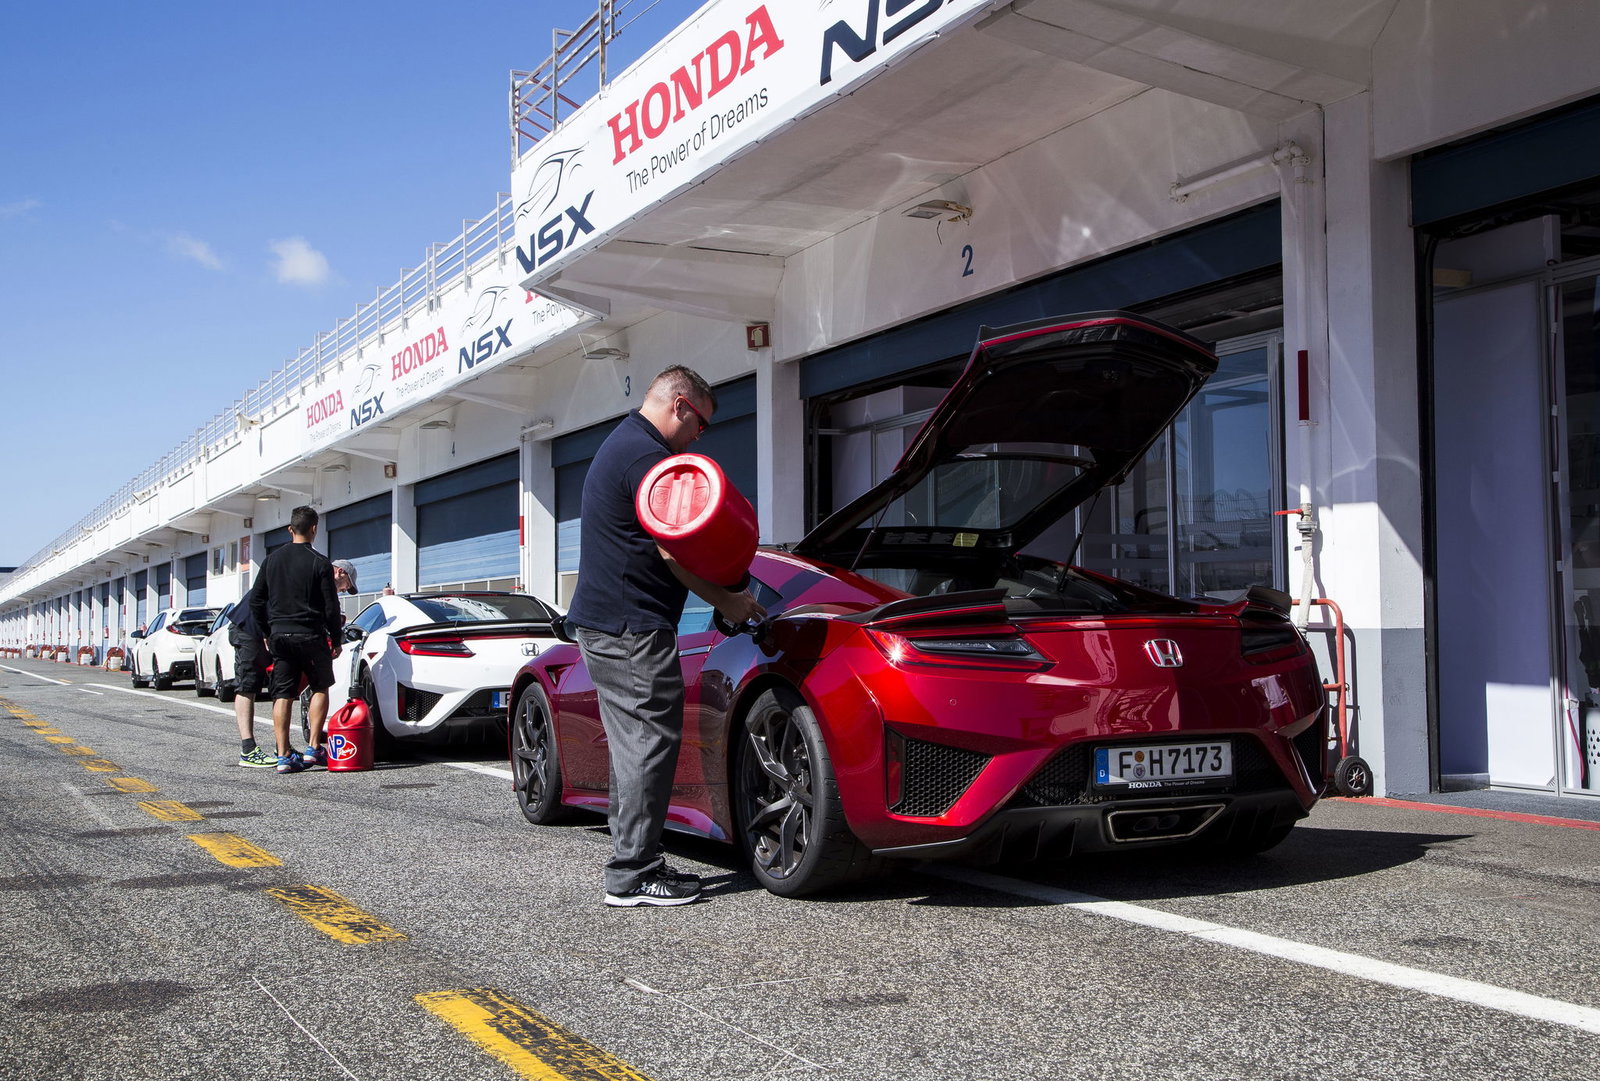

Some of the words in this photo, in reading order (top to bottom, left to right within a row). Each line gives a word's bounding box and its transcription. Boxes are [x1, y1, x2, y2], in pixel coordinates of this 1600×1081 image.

[607, 4, 784, 166] HONDA
[626, 167, 649, 194] The
[650, 137, 691, 179] Power
[693, 121, 707, 151] of
[710, 87, 768, 140] Dreams
[516, 189, 596, 274] NSX
[961, 244, 974, 277] 2
[391, 326, 449, 381] HONDA
[458, 317, 514, 375] NSX
[624, 375, 631, 397] 3
[306, 389, 344, 429] HONDA
[350, 391, 384, 430] NSX
[1118, 751, 1133, 778] F
[1128, 781, 1162, 789] HONDA
